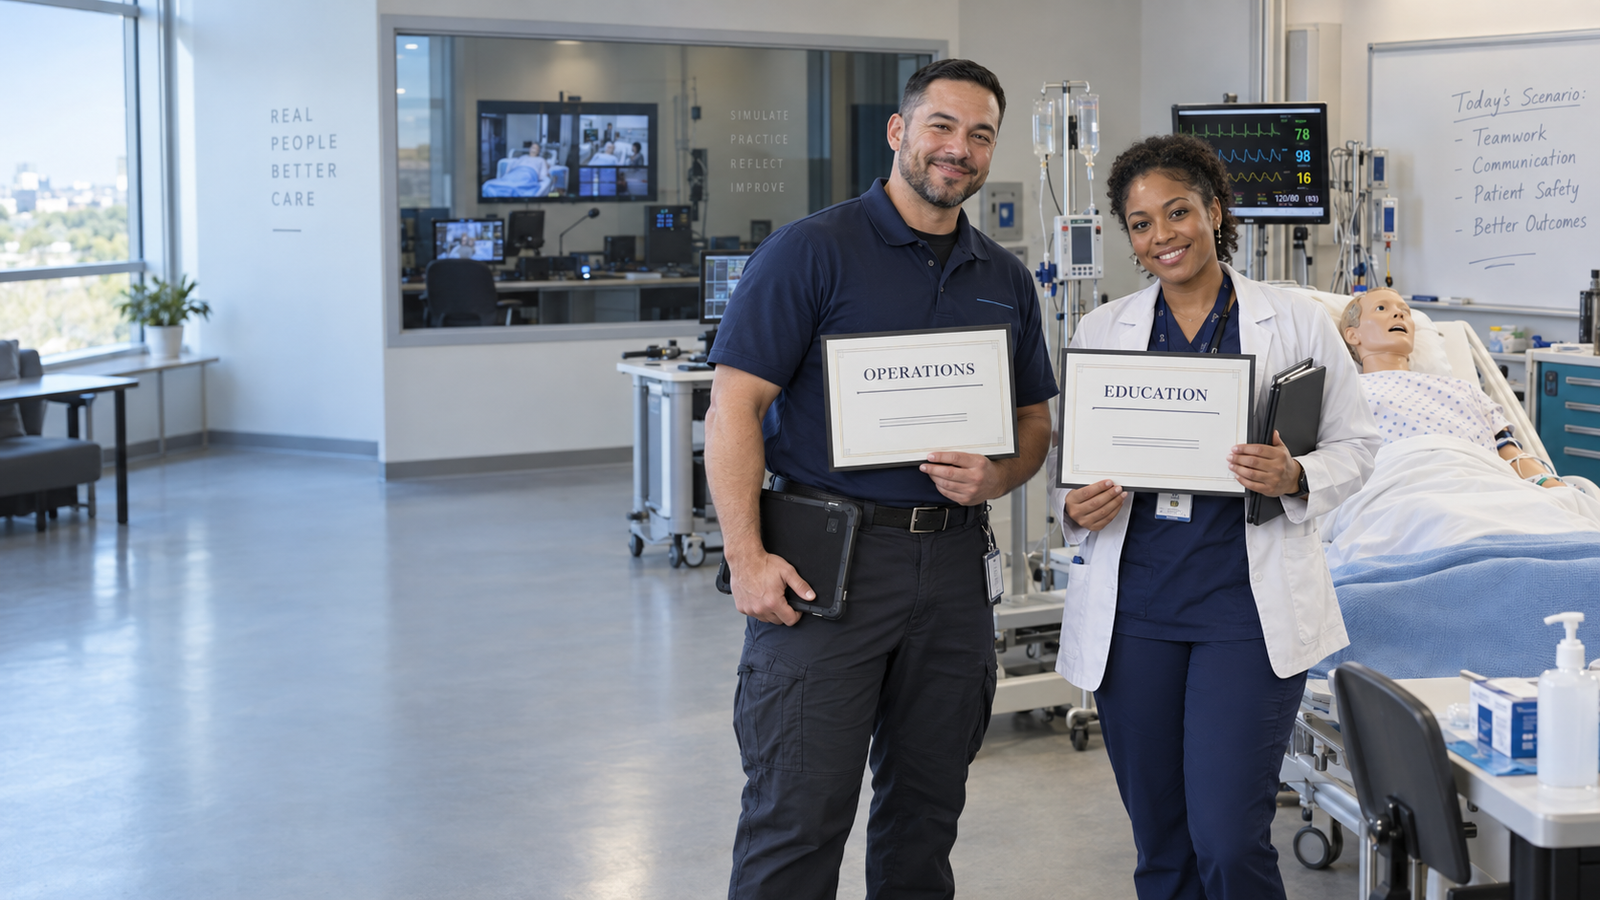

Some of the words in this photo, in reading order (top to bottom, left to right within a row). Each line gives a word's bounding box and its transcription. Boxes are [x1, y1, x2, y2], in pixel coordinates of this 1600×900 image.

[1451, 88, 1510, 117] Today's
[1521, 87, 1586, 107] Scenario:
[271, 107, 313, 123] REAL
[730, 110, 789, 121] SIMULATE
[730, 134, 788, 145] PRACTICE
[1294, 128, 1310, 141] 78
[1472, 123, 1547, 146] Teamwork
[271, 134, 338, 151] PEOPLE
[730, 158, 783, 169] REFLECT
[1295, 149, 1311, 163] 98
[1472, 148, 1576, 174] Communication
[272, 163, 337, 178] BETTER
[1296, 171, 1312, 184] 16
[730, 182, 785, 193] IMPROVE
[1474, 182, 1525, 204] Patient
[1535, 179, 1579, 204] Safety
[271, 191, 315, 206] CARE
[1275, 194, 1300, 203] 120/80
[1473, 215, 1519, 237] Better
[1526, 213, 1587, 233] Outcomes
[863, 362, 975, 381] OPERATIONS
[1104, 384, 1208, 402] EDUCATION
